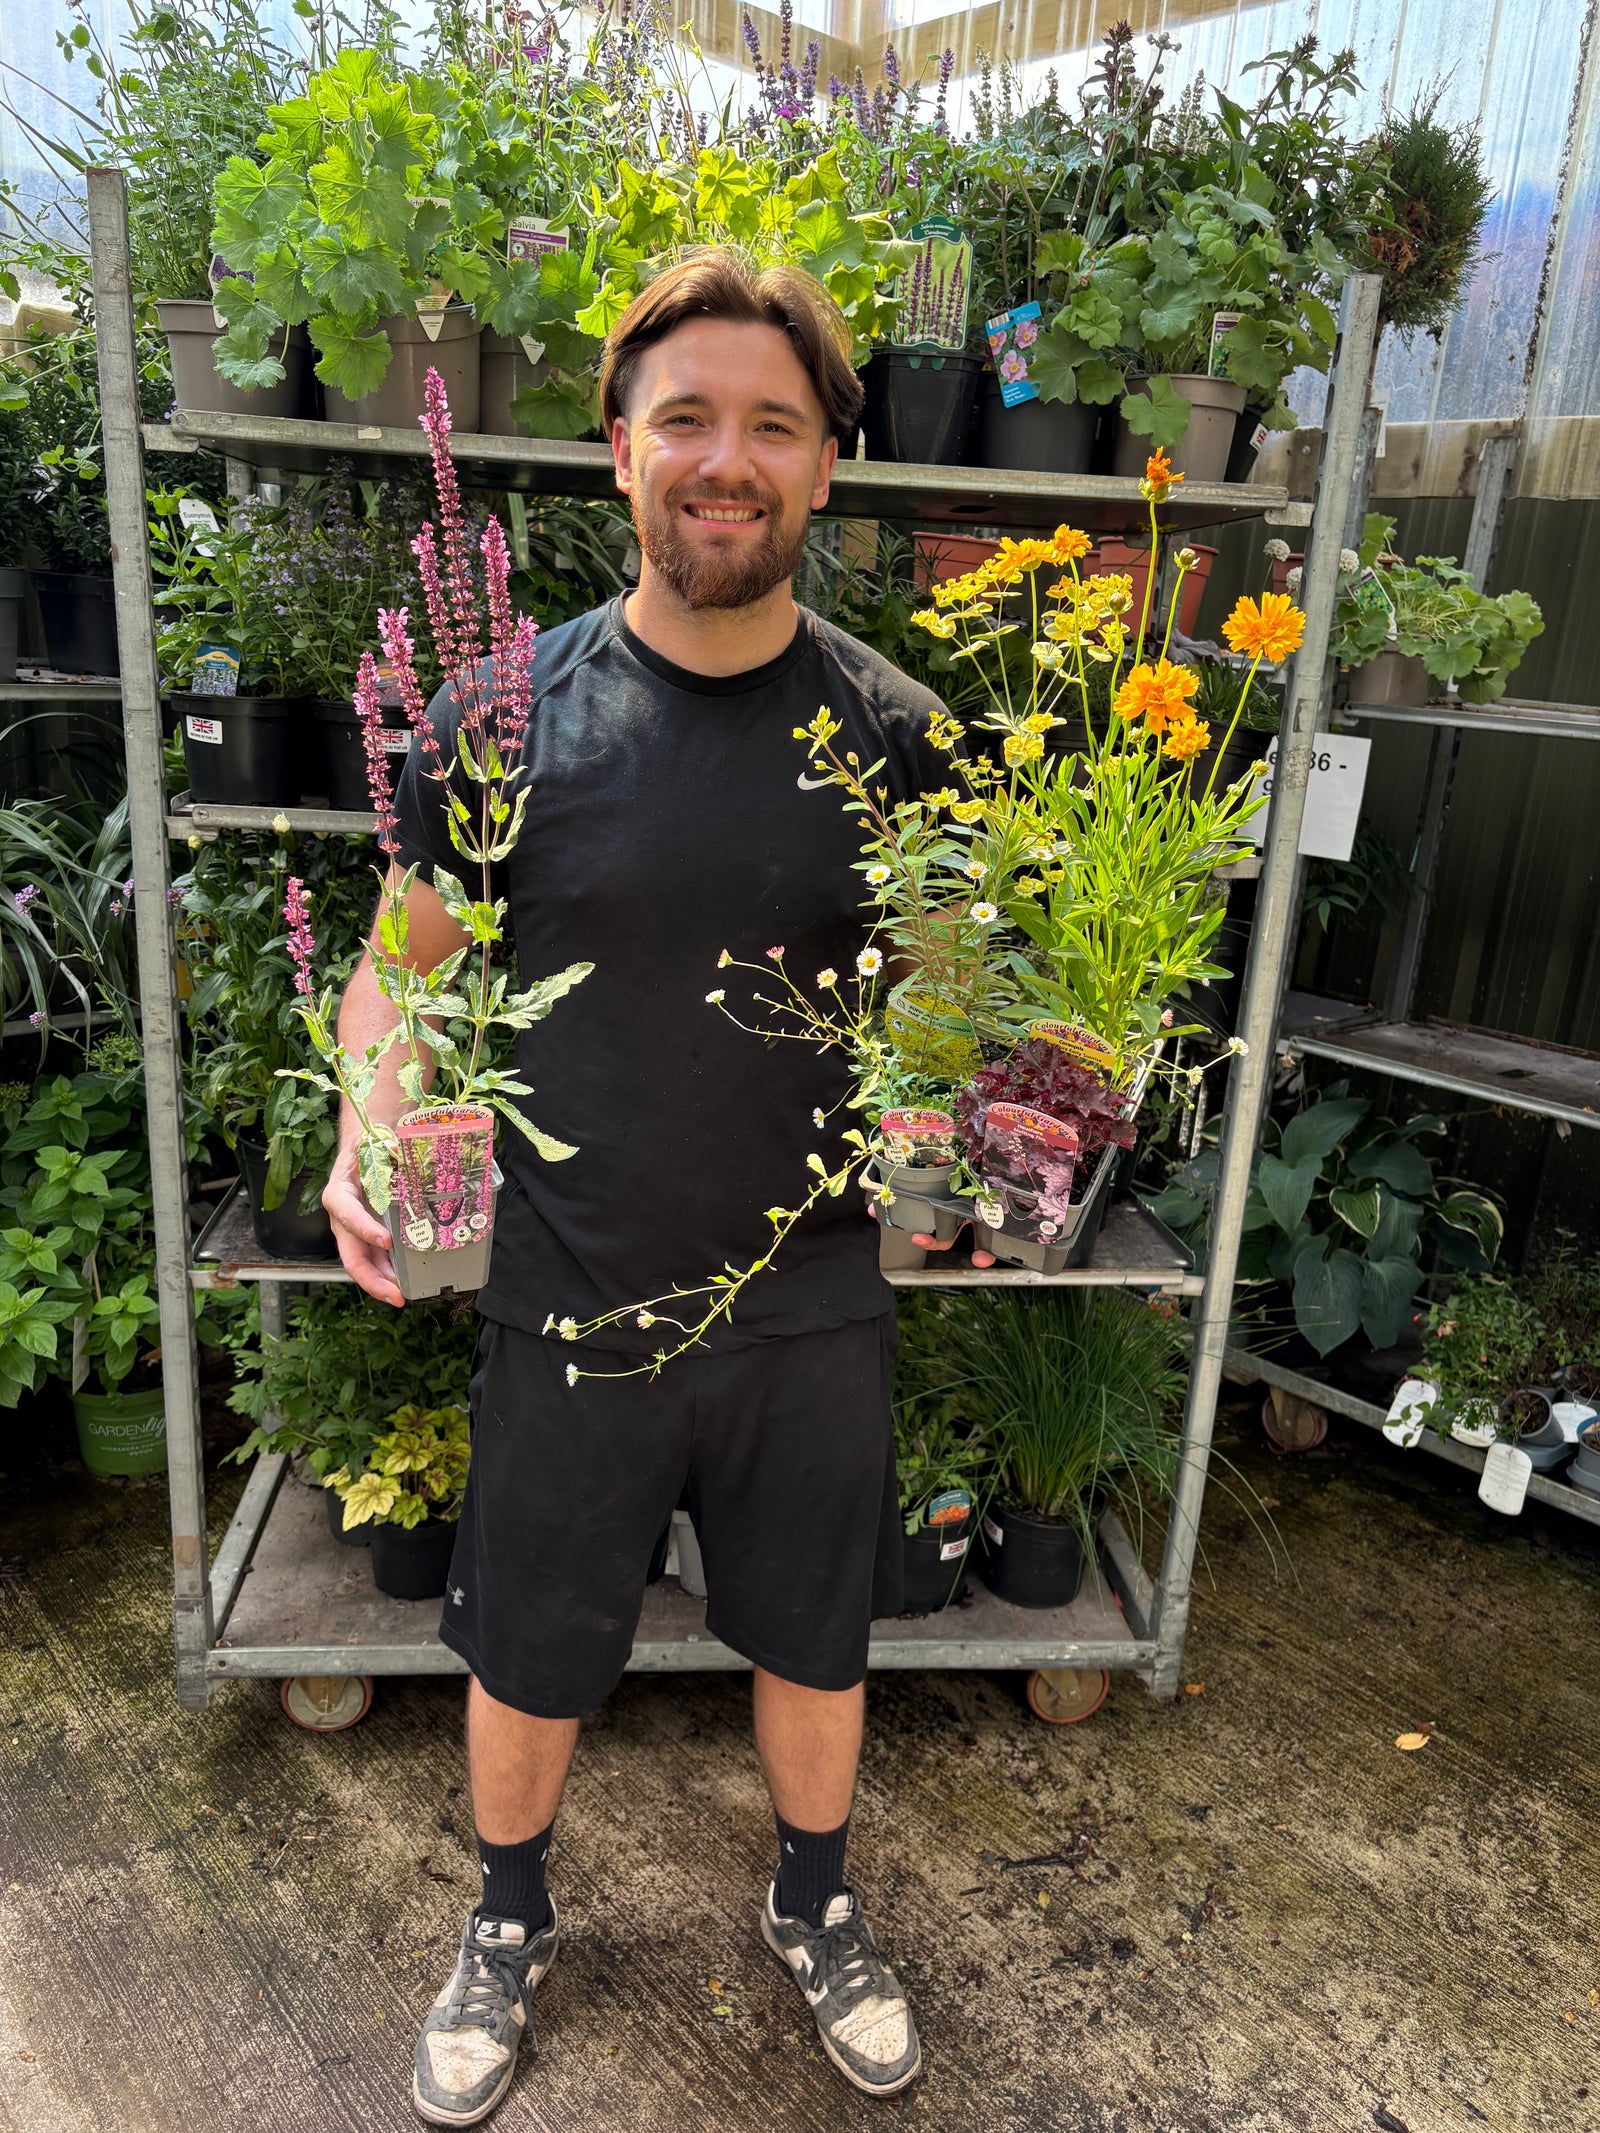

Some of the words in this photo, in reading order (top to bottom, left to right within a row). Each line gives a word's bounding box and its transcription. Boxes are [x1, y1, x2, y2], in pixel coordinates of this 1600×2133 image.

[511, 219, 536, 231] Salvia
[1035, 1021, 1078, 1036] Colourful
[1078, 1030, 1112, 1055] Gardens
[1058, 1040, 1085, 1052] Coreopsis
[402, 1107, 451, 1127] Colourful
[452, 1107, 489, 1118] Gardens
[920, 1110, 950, 1123] Gardens
[991, 1105, 1036, 1120] Colourful
[1037, 1115, 1073, 1140] Gardens
[1017, 1123, 1044, 1136] Heuchera
[409, 1222, 426, 1233] Plant
[416, 1236, 430, 1245] now
